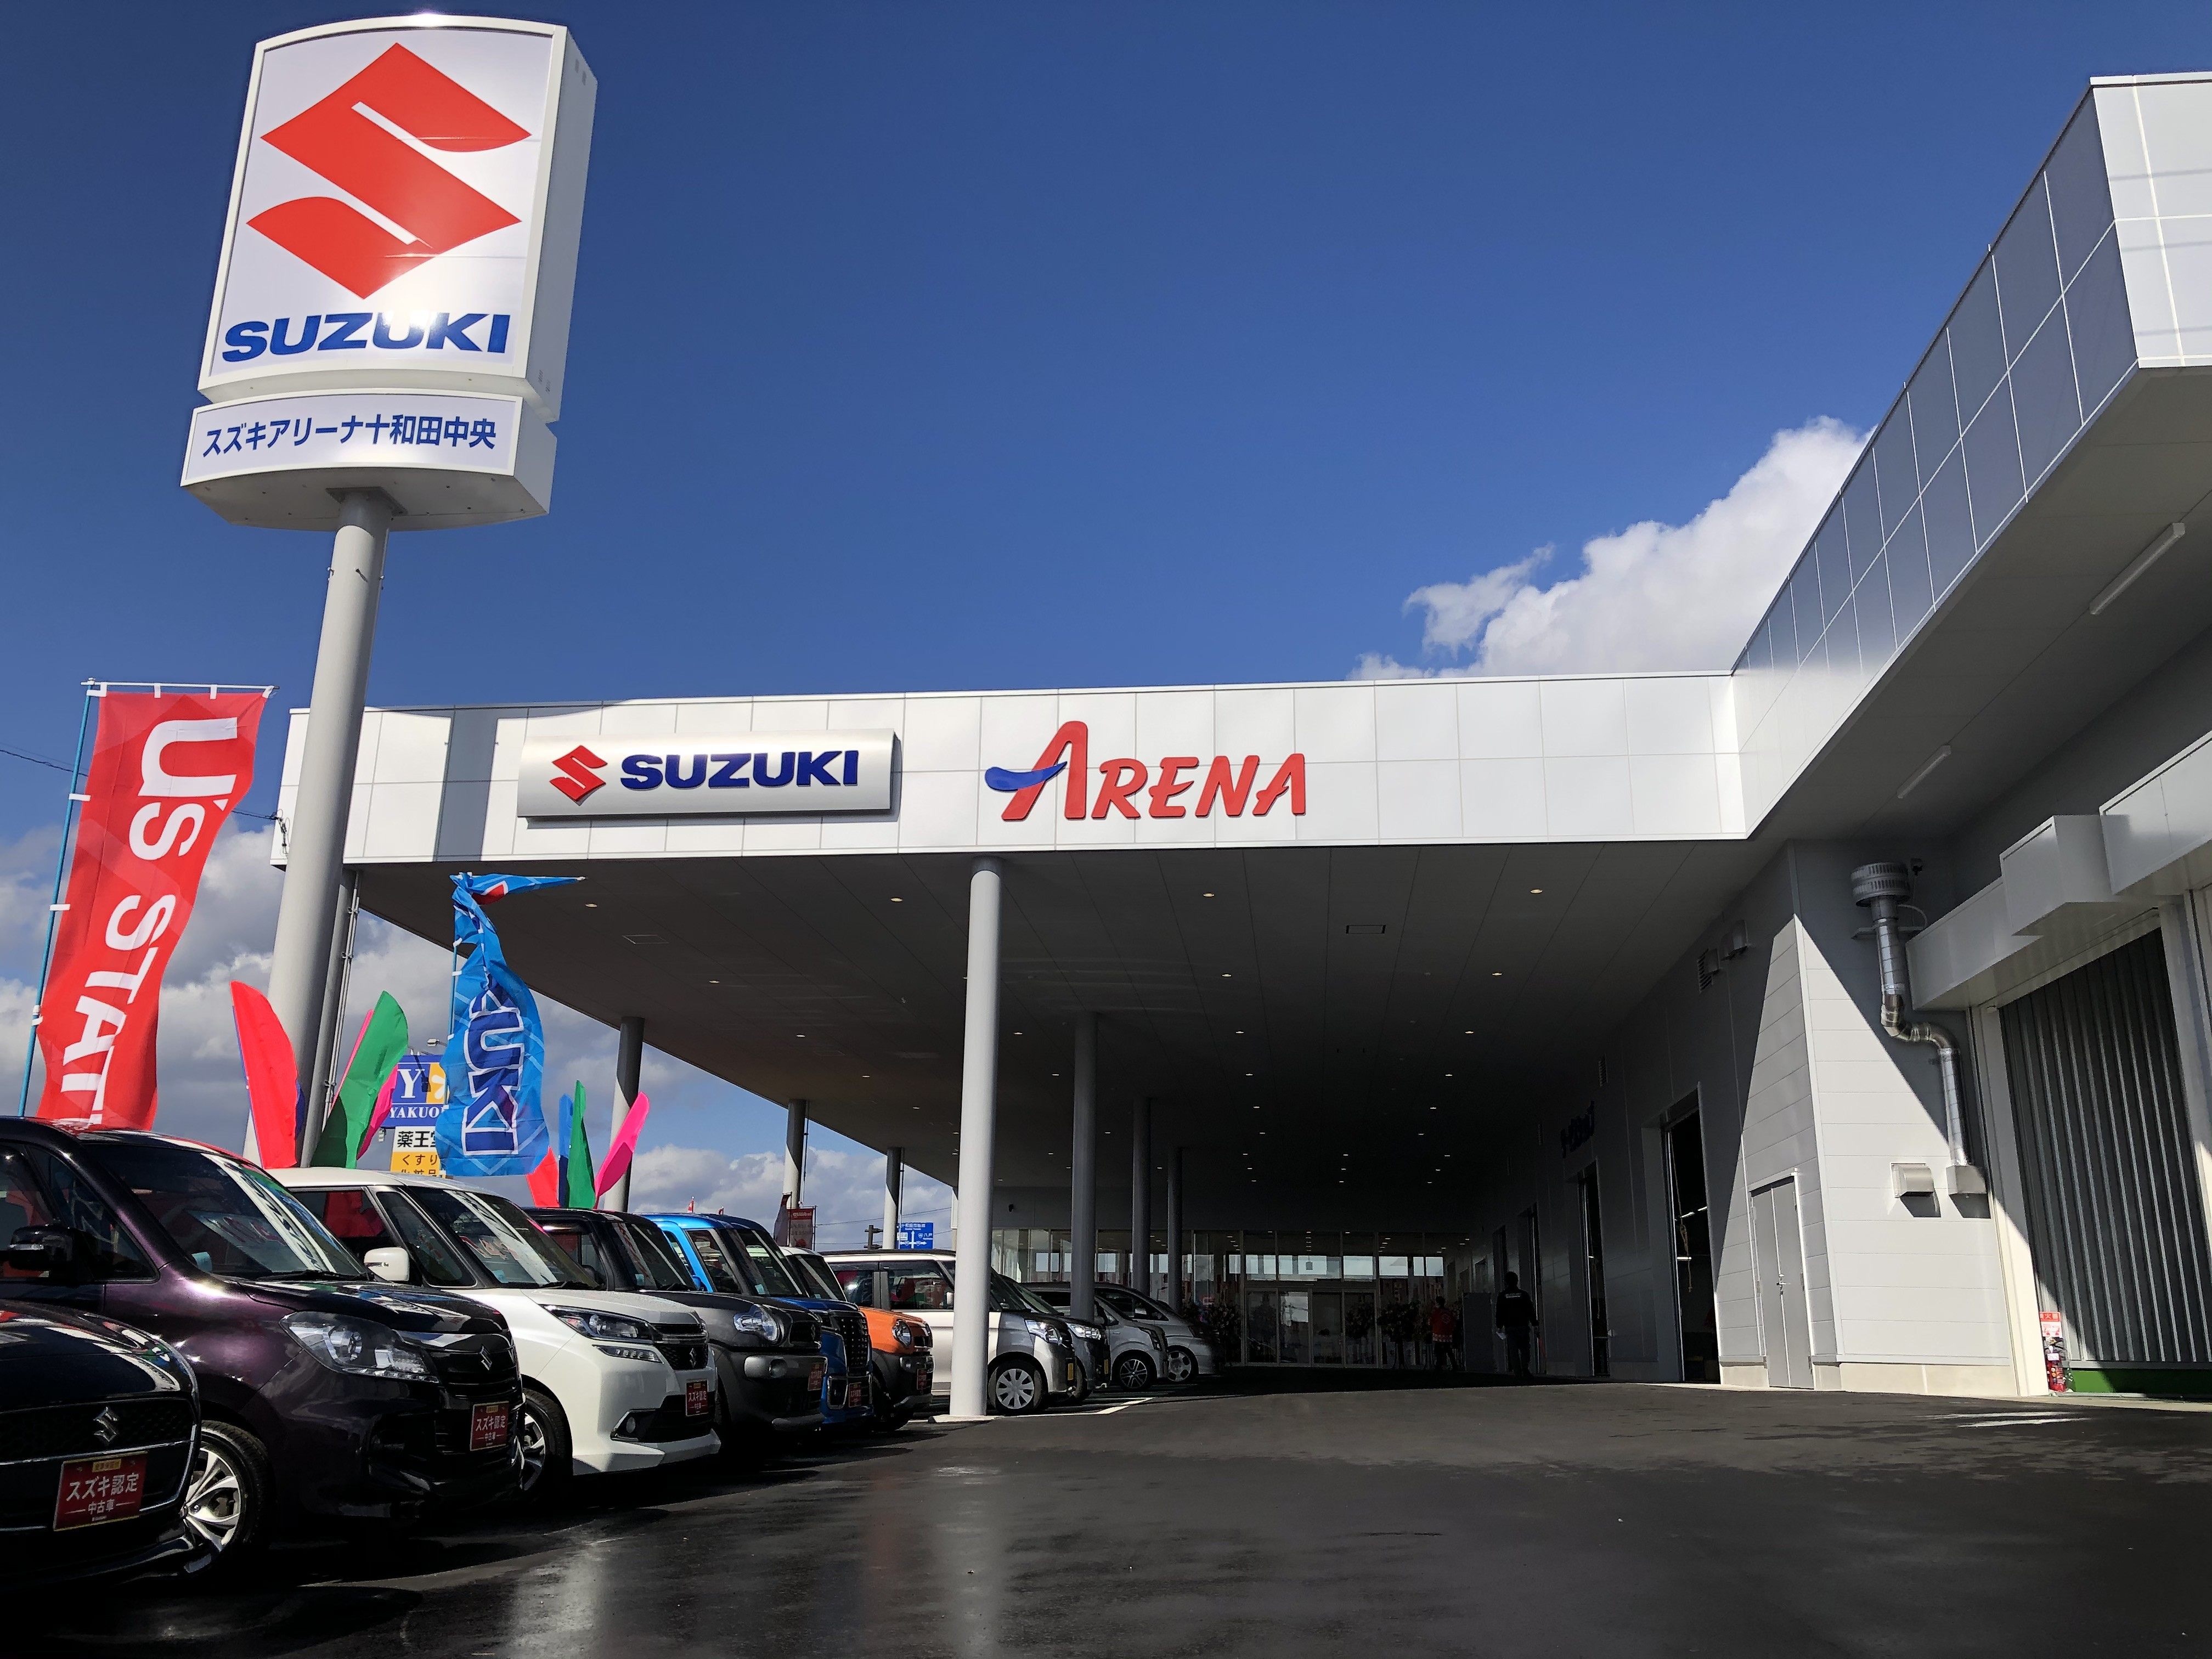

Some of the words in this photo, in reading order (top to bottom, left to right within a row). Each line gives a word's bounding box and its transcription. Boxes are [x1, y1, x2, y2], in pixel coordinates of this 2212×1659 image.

[221, 312, 511, 363] SUZUKI
[202, 414, 497, 458] スズキアリーナ十和田中央
[129, 716, 237, 861] U'S
[620, 749, 859, 791] SUZUKI
[985, 720, 1306, 821] ARENA
[402, 1154, 438, 1165] くすり
[66, 1472, 139, 1502] スズキ認定
[88, 1498, 115, 1515] 中古車
